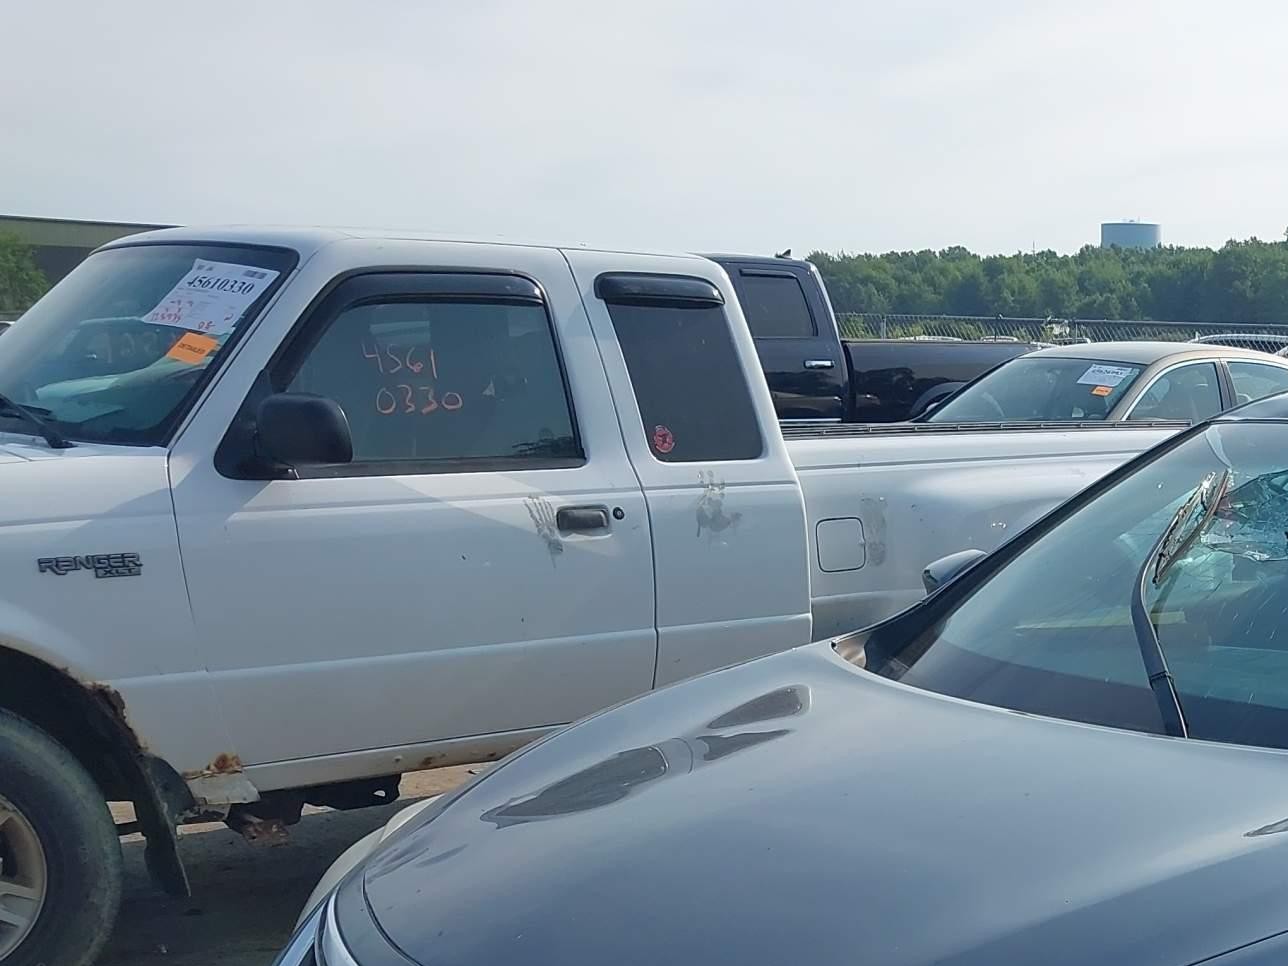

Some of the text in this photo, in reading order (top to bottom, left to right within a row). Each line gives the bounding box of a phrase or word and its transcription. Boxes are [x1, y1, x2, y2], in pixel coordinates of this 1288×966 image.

[186, 276, 255, 295] 45610330
[361, 342, 438, 379] 4561
[376, 384, 463, 414] 0330
[38, 553, 143, 576] RANGER
[101, 568, 138, 577] XLT
